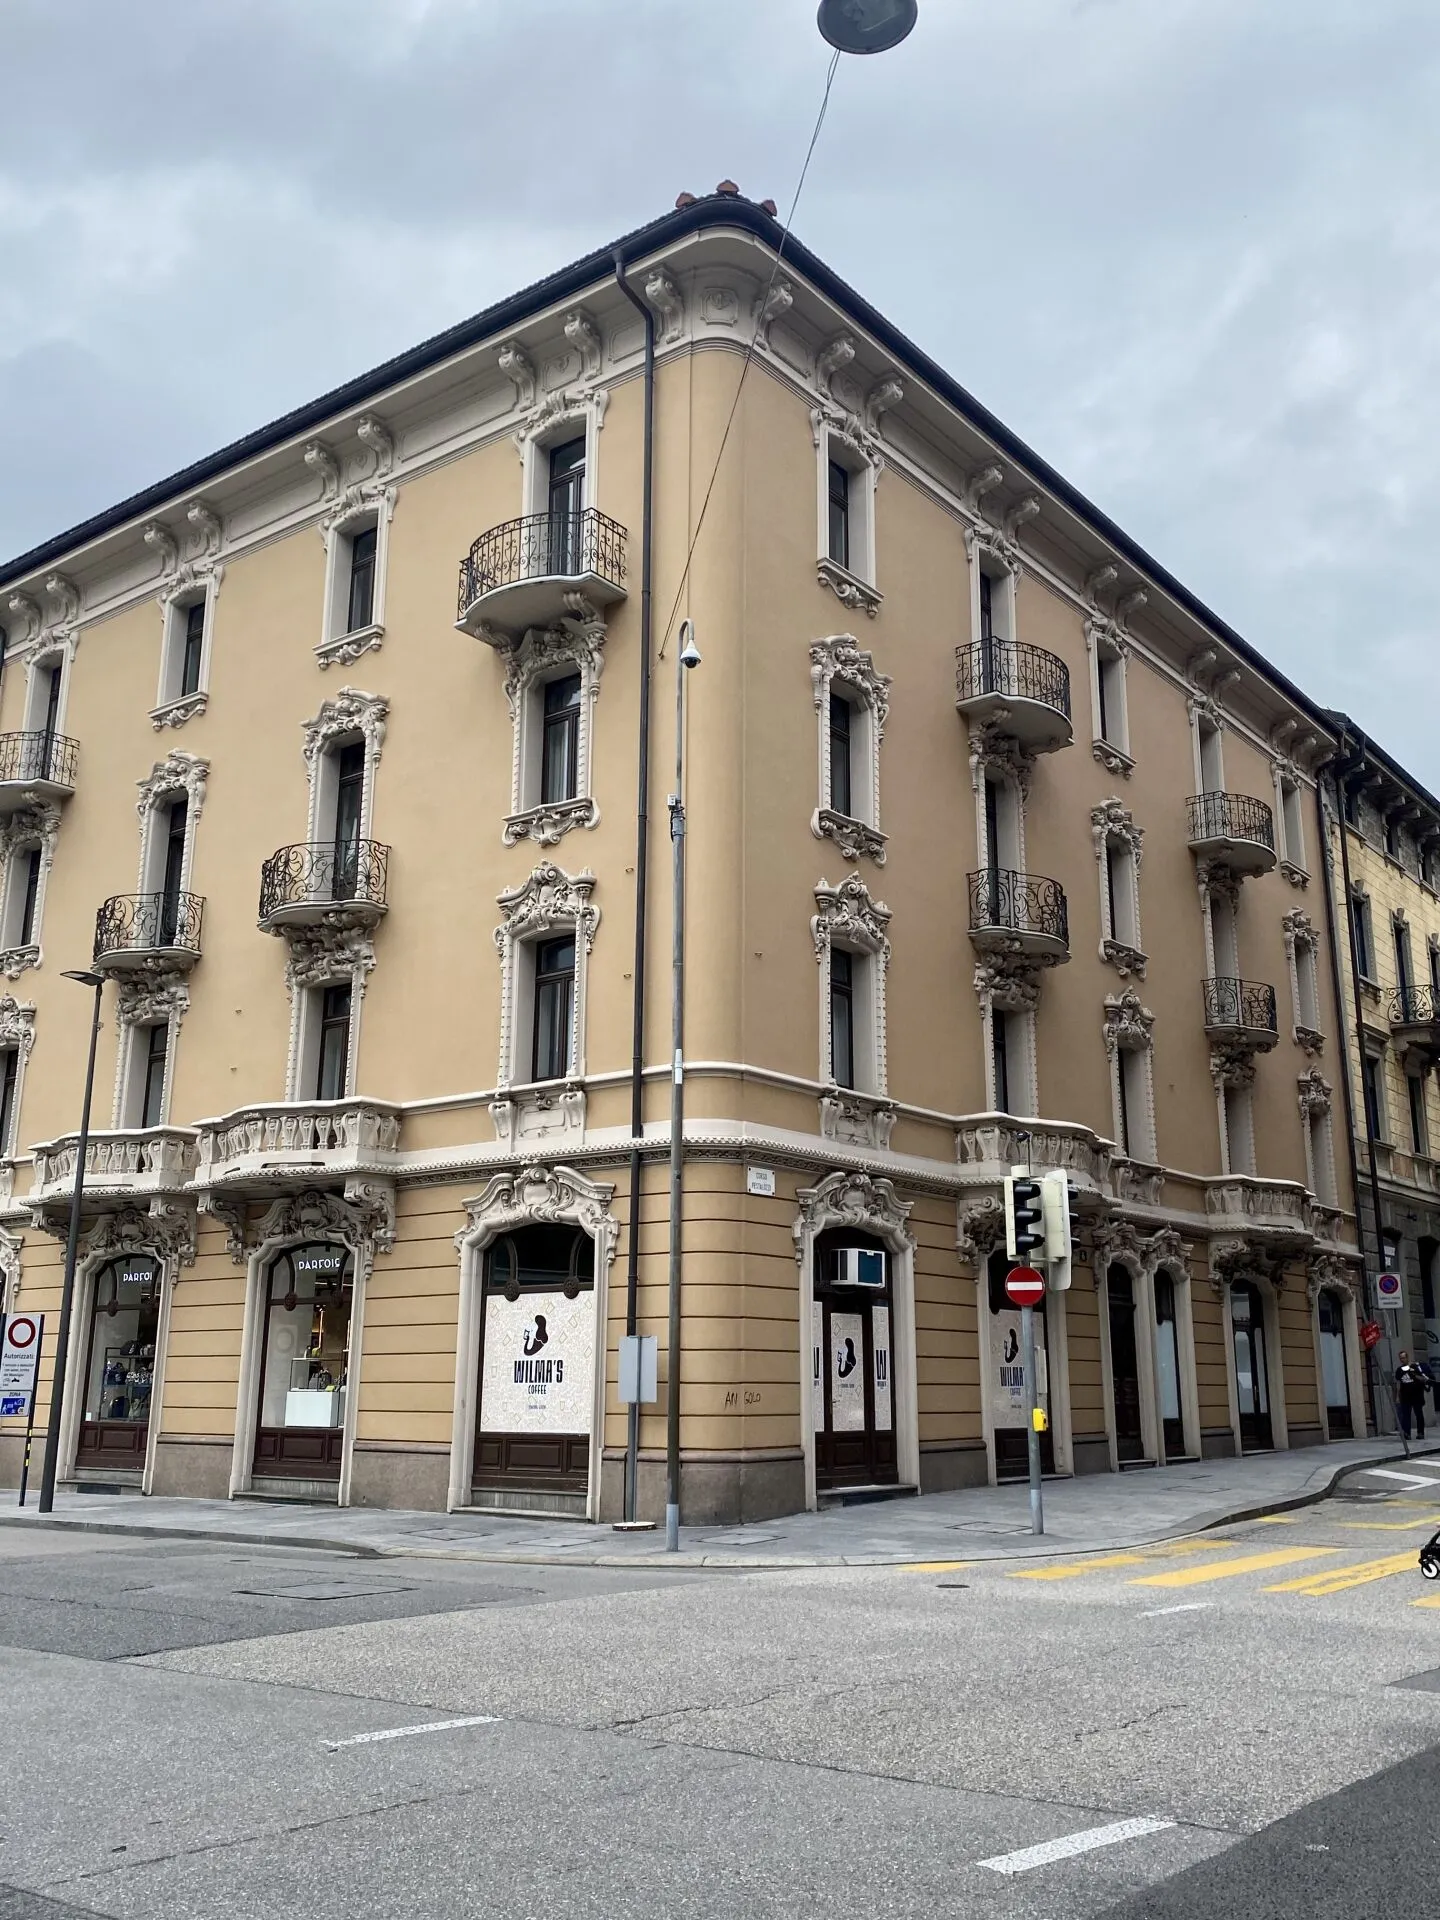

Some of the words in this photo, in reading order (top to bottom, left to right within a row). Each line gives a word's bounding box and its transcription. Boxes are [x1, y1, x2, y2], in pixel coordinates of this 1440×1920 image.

[123, 1271, 153, 1281] PARFOI
[514, 1360, 563, 1383] WILMA'S
[1000, 1366, 1024, 1387] WILMA'
[528, 1384, 547, 1394] COFFEE
